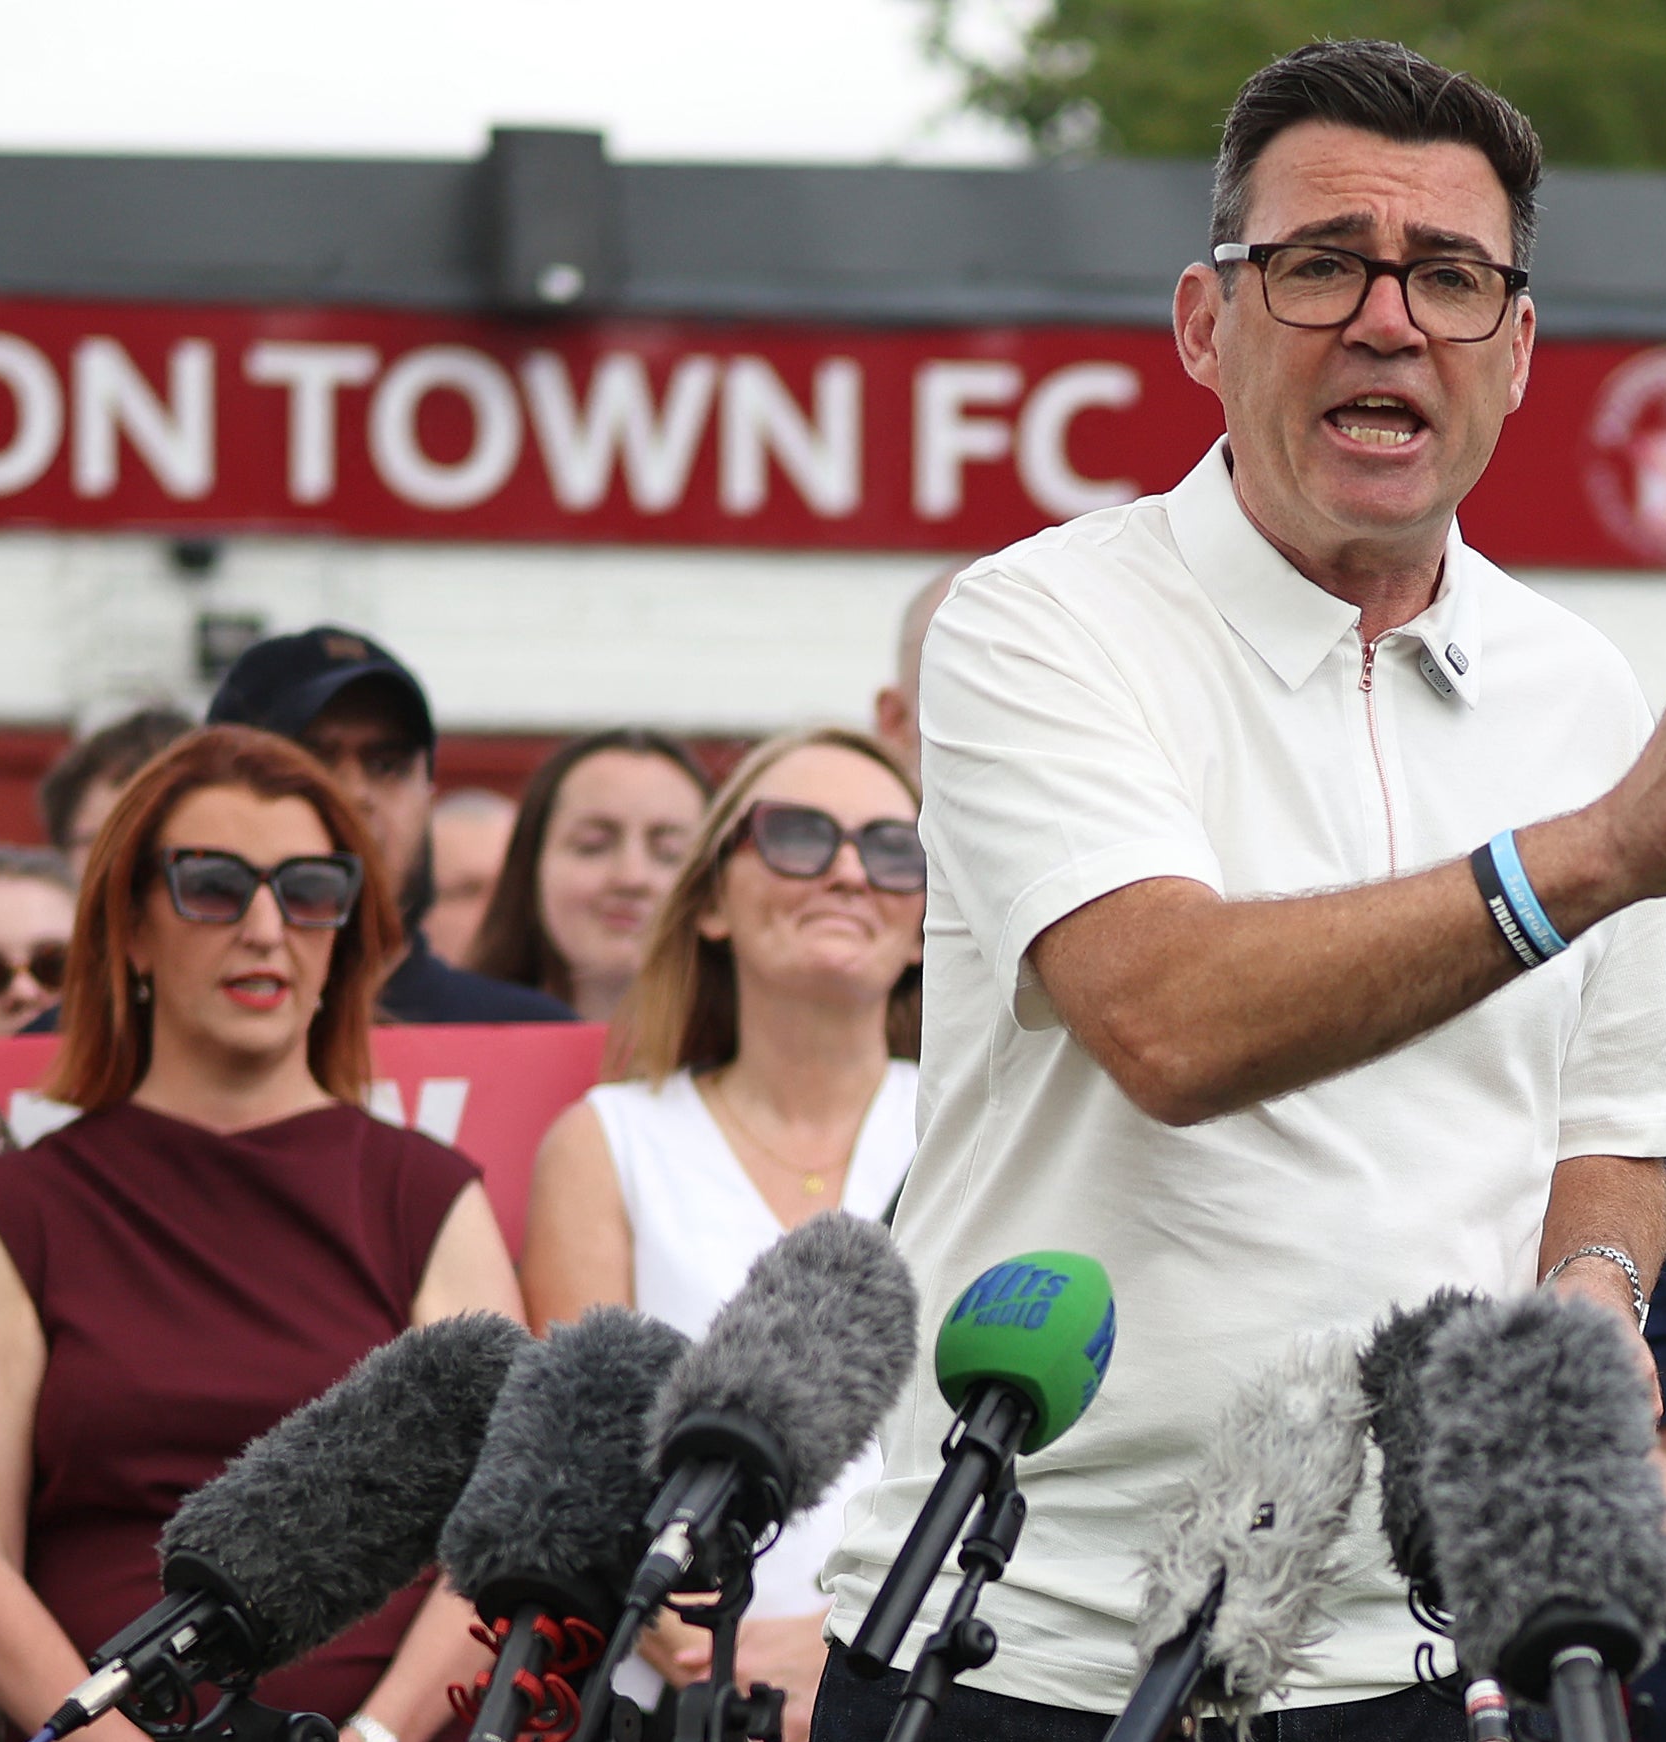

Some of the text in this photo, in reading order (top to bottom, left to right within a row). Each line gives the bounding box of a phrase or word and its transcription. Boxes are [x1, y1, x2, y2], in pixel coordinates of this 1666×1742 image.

[245, 342, 864, 517] TOWN
[913, 361, 1141, 516] FC
[950, 1262, 1070, 1325] HITS
